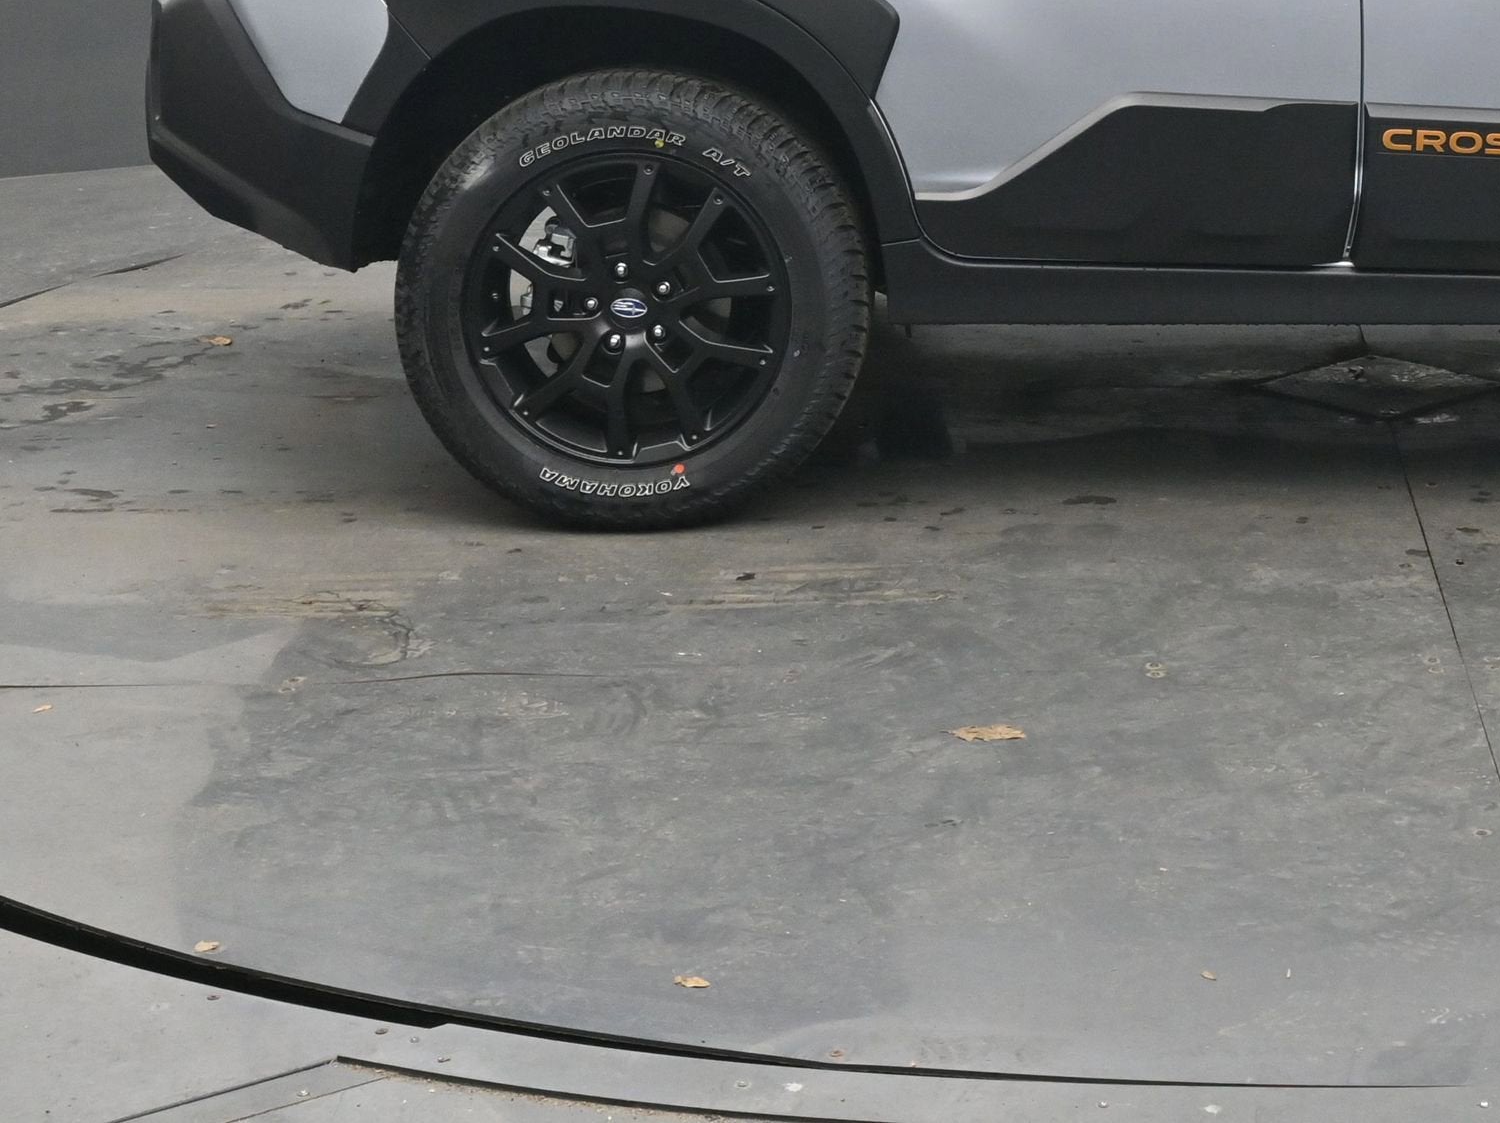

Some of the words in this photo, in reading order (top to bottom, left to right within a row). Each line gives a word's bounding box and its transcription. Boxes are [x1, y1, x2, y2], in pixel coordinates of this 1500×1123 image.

[519, 125, 686, 168] GEOLANDAR
[703, 146, 752, 179] A/T
[539, 467, 691, 498] YOKOHAMA
